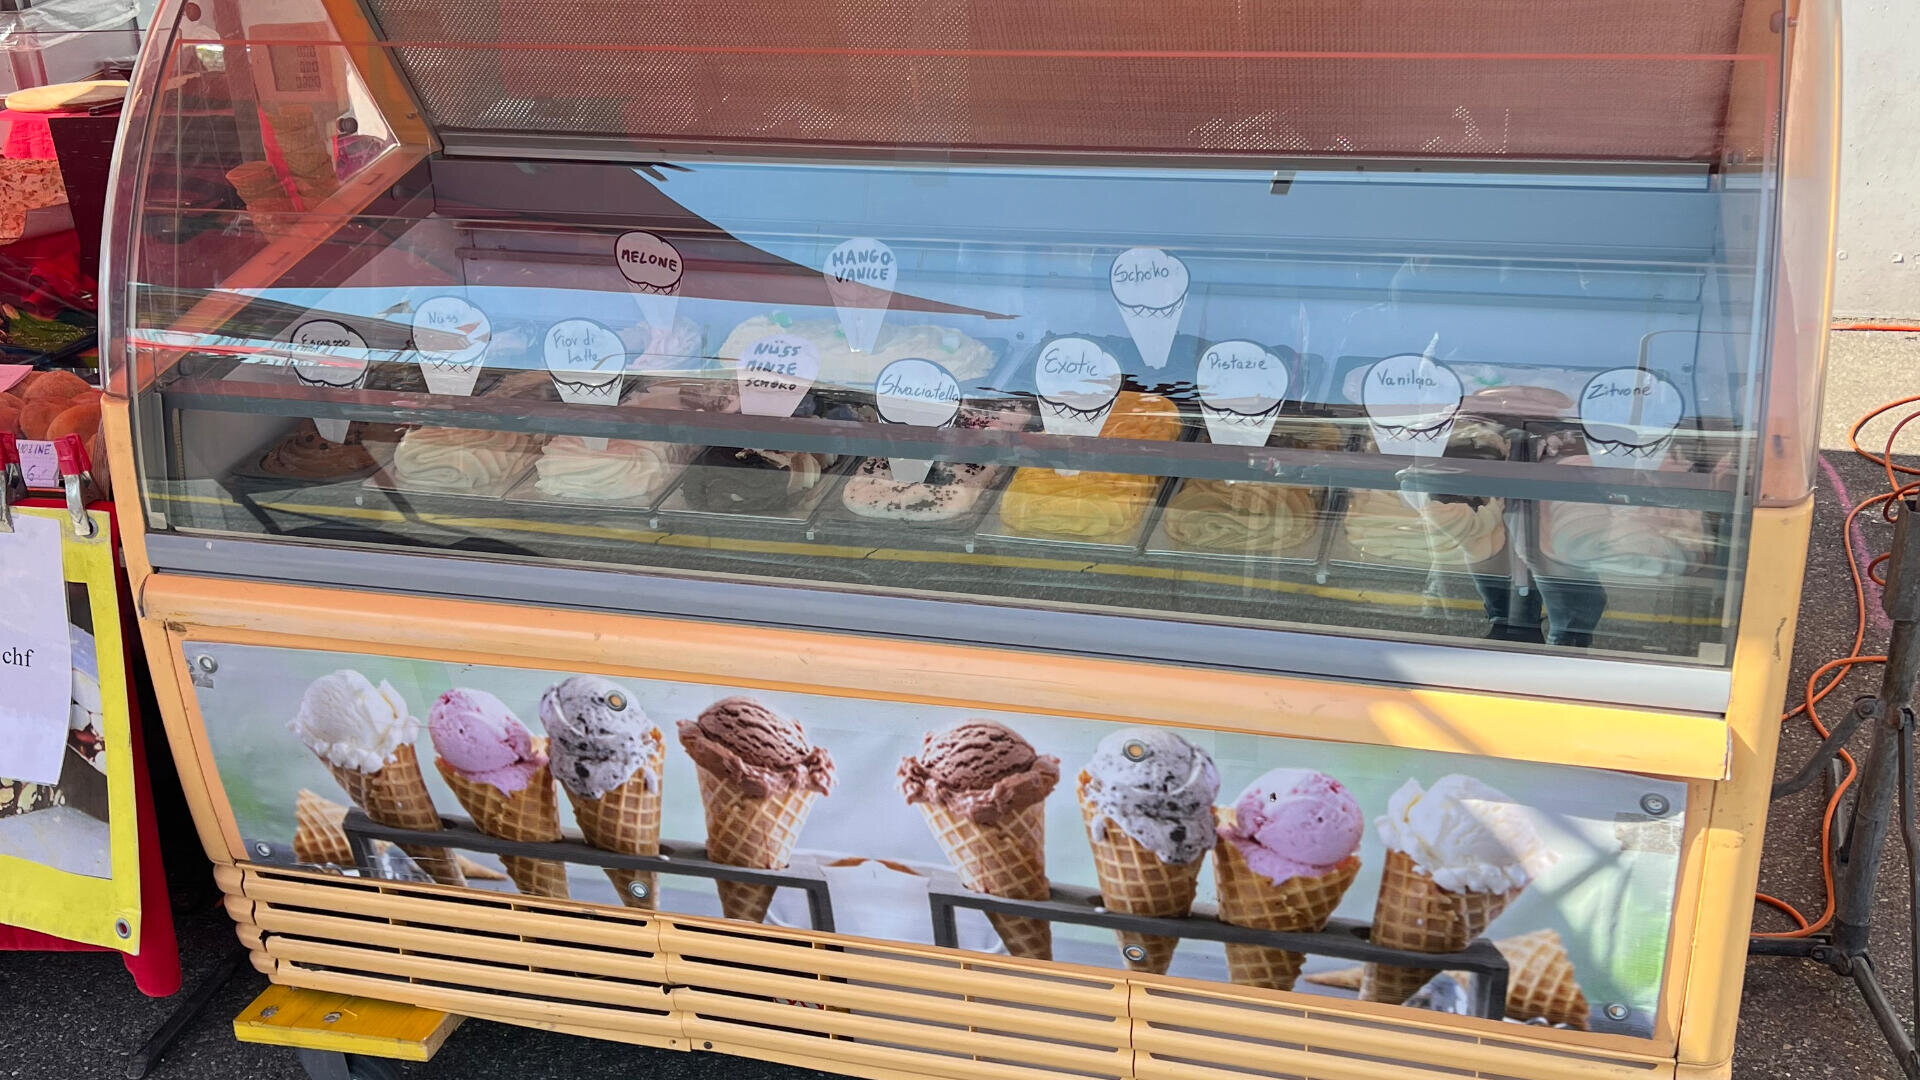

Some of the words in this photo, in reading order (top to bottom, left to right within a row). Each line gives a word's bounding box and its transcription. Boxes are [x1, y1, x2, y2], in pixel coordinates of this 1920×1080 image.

[621, 248, 678, 272] MELONE
[1113, 261, 1169, 282] Schoko
[583, 327, 594, 346] di
[567, 349, 598, 364] Latte
[1044, 347, 1099, 377] Exotic
[1206, 352, 1268, 370] Pistazie
[746, 359, 797, 376] MINZE
[745, 379, 797, 391] SCHOKO
[1586, 383, 1652, 400] Zitrone
[2, 646, 35, 668] chf
